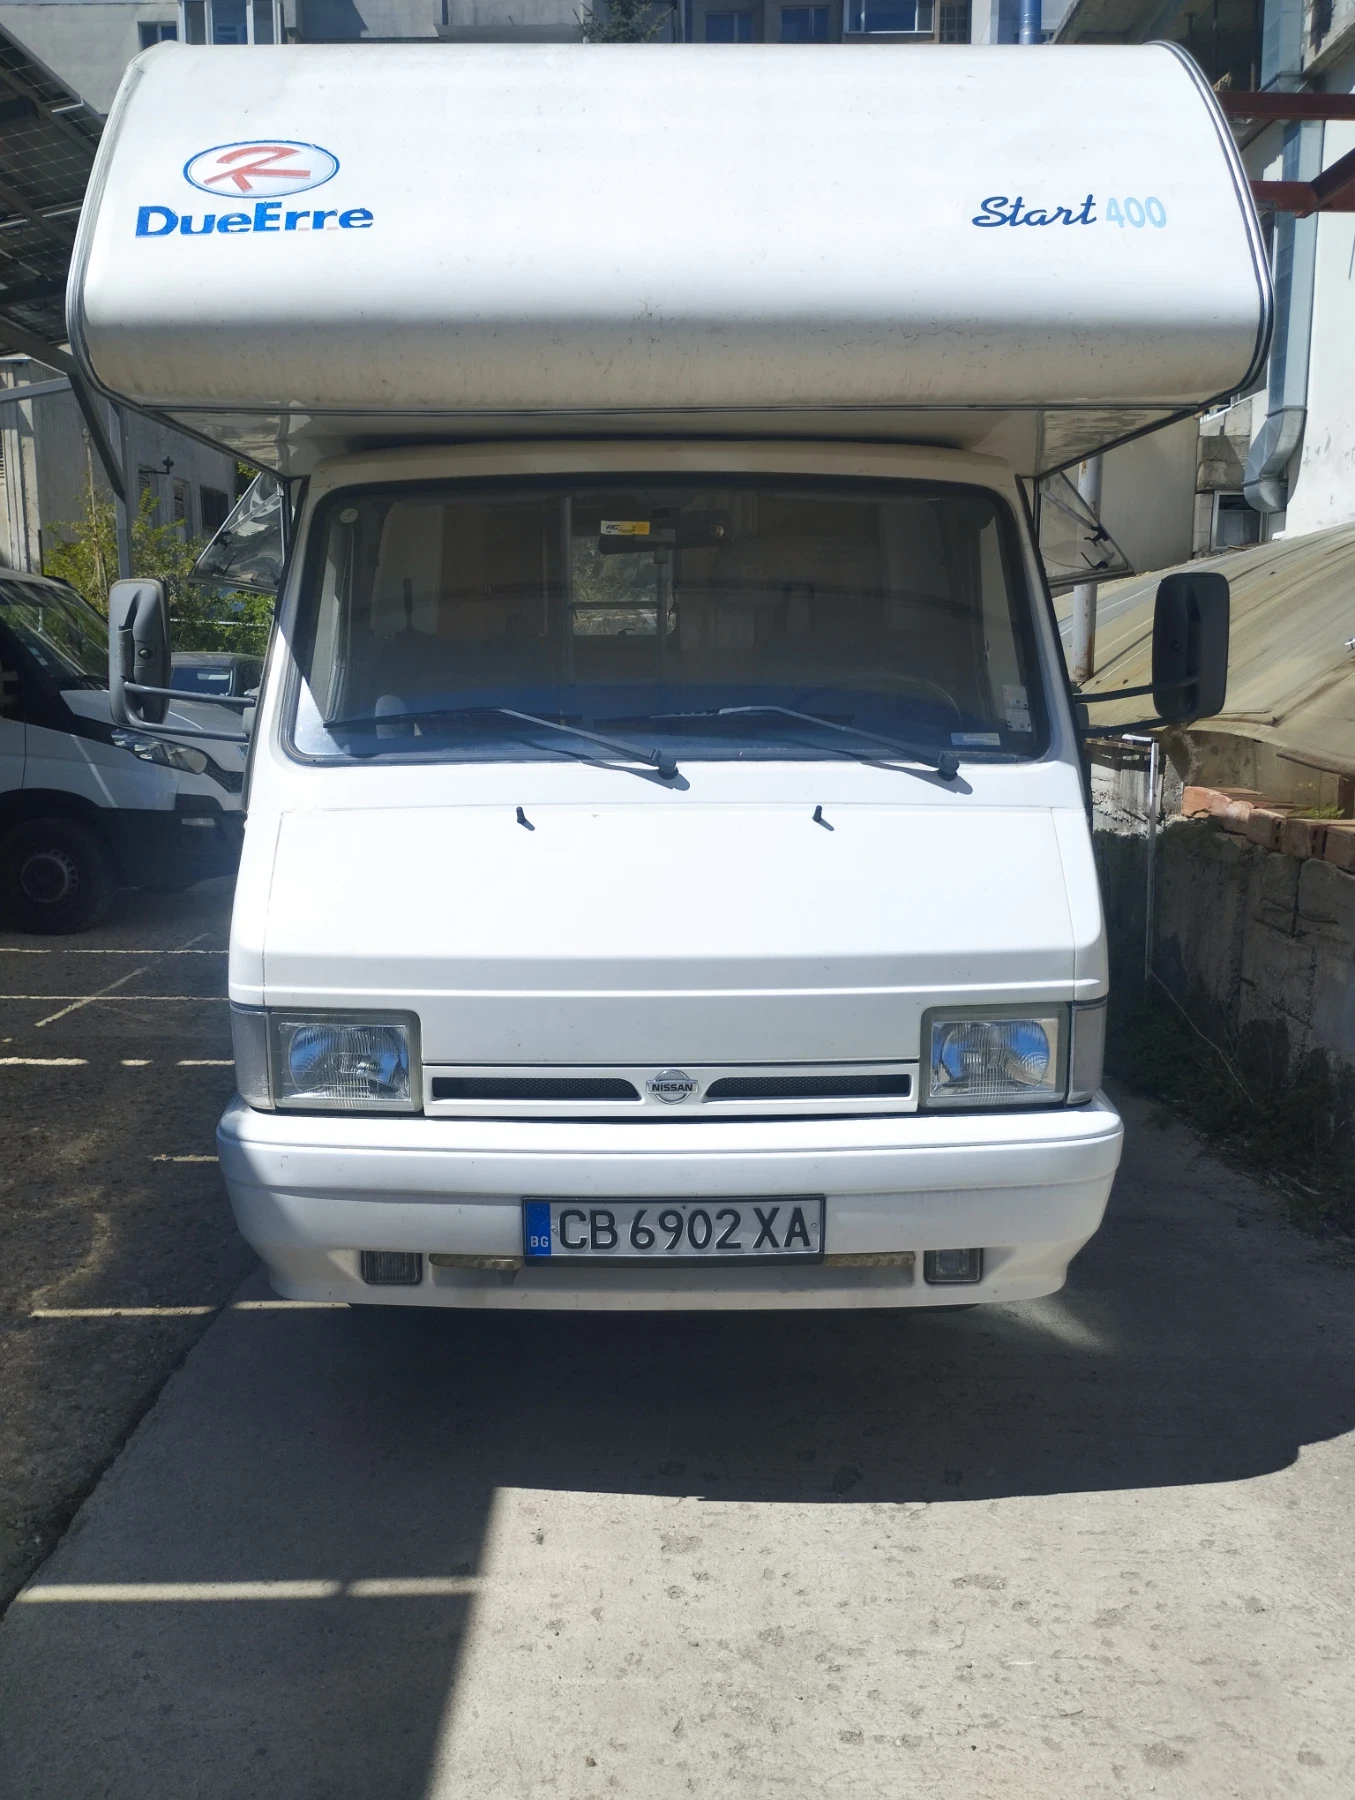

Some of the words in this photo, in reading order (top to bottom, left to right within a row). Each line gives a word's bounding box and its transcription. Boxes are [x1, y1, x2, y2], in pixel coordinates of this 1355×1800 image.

[135, 201, 374, 238] DueErre
[971, 193, 1097, 228] Start
[1105, 196, 1167, 229] 400
[651, 1083, 693, 1092] NISSAN
[529, 1235, 549, 1249] BG
[558, 1209, 619, 1251] CB
[629, 1208, 742, 1251] 6902
[752, 1206, 811, 1249] XA
